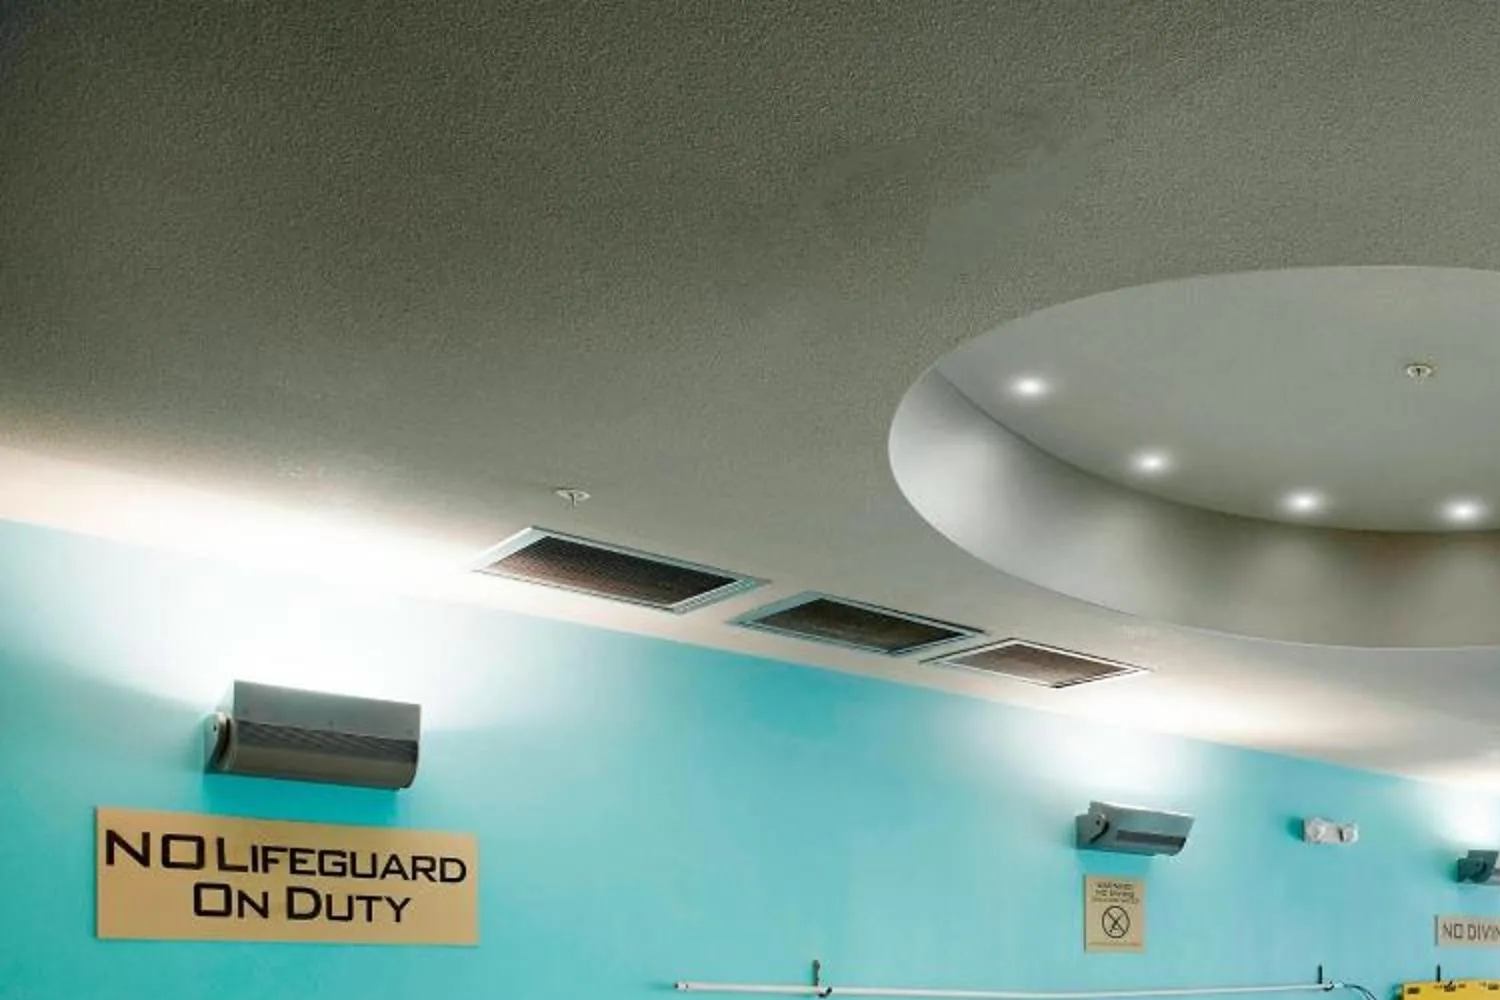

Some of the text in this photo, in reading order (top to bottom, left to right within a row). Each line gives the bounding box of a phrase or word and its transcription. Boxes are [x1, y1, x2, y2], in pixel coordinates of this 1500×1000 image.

[105, 829, 467, 883] NO LIFEGUARD
[193, 882, 411, 923] ON DUTY
[1443, 922, 1464, 939] NO
